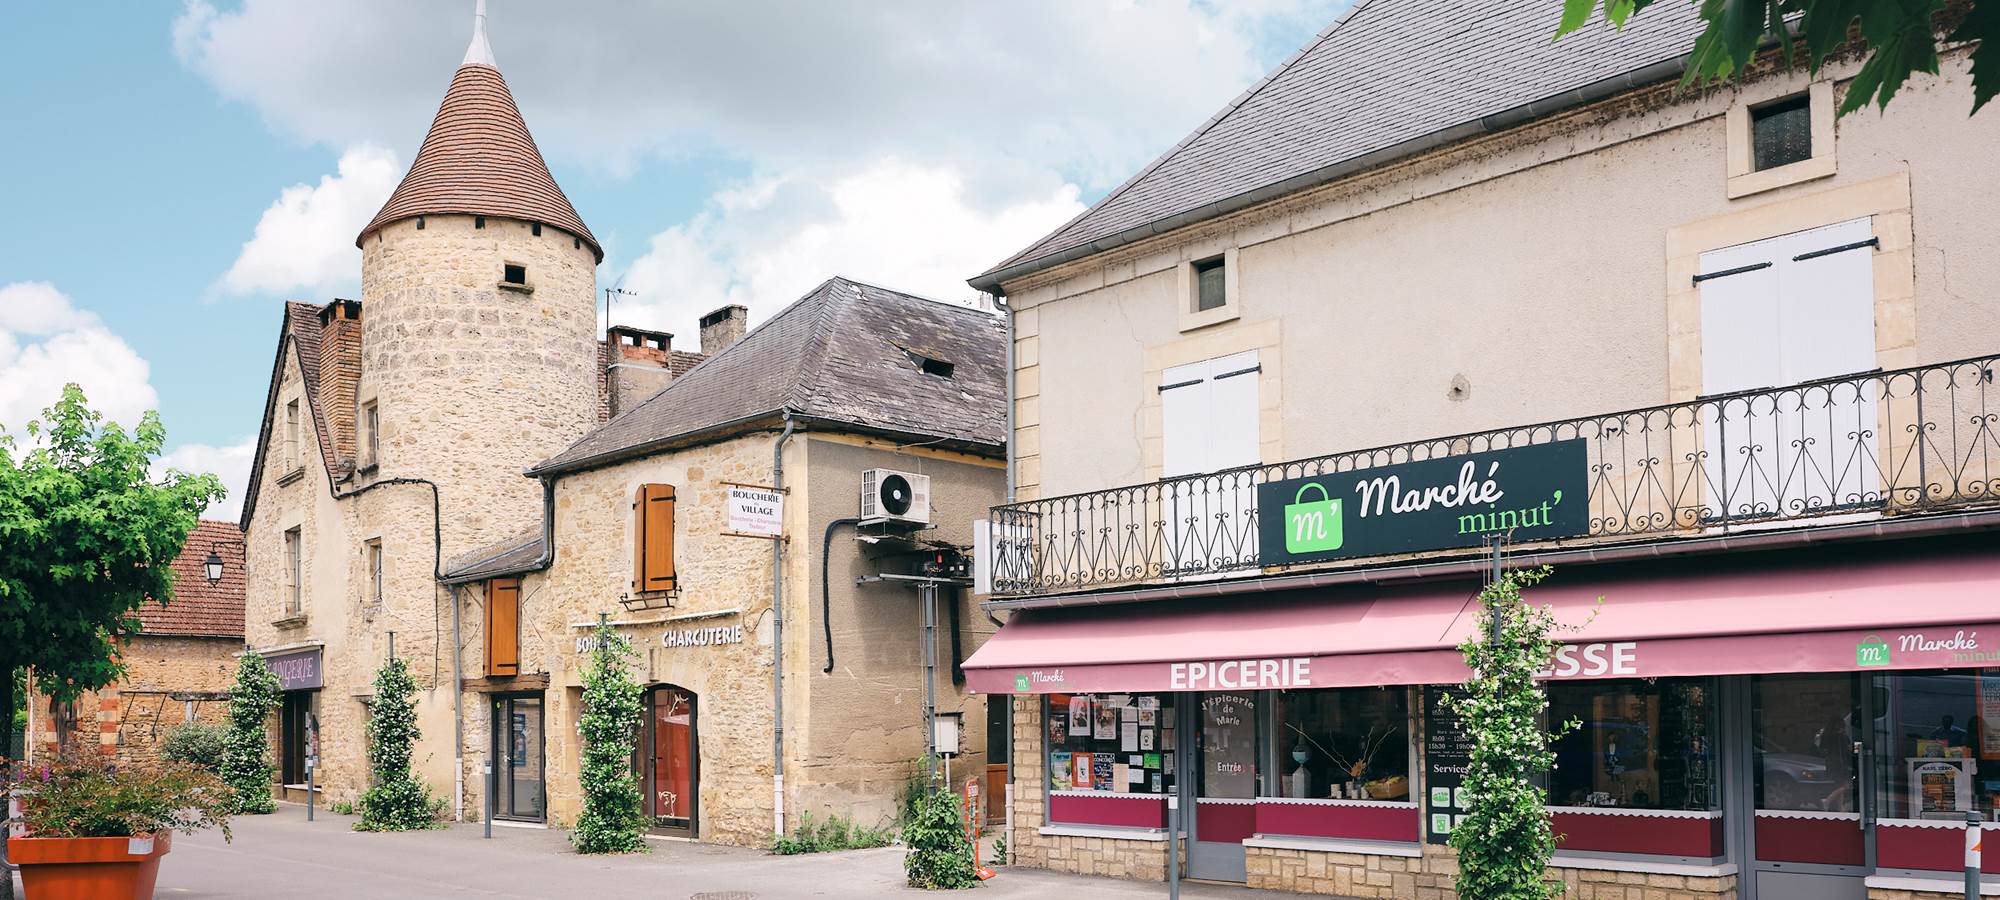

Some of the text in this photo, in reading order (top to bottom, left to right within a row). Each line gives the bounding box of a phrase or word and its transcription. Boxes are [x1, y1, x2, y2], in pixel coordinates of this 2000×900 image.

[733, 490, 780, 503] BOUCHERIE
[1355, 460, 1504, 518] Marché
[741, 505, 774, 516] VILLAGE
[1458, 490, 1562, 534] minut'
[1293, 502, 1338, 542] m'
[662, 624, 743, 648] CHARCUTERIE
[1898, 630, 1979, 652] Marché
[1474, 642, 1637, 682] ESSE
[1031, 669, 1065, 683] Marché
[1170, 658, 1311, 689] EPICERIE
[1222, 705, 1234, 713] de
[1216, 716, 1240, 726] Marie
[1217, 762, 1242, 772] Entrée
[1433, 764, 1470, 775] Services
